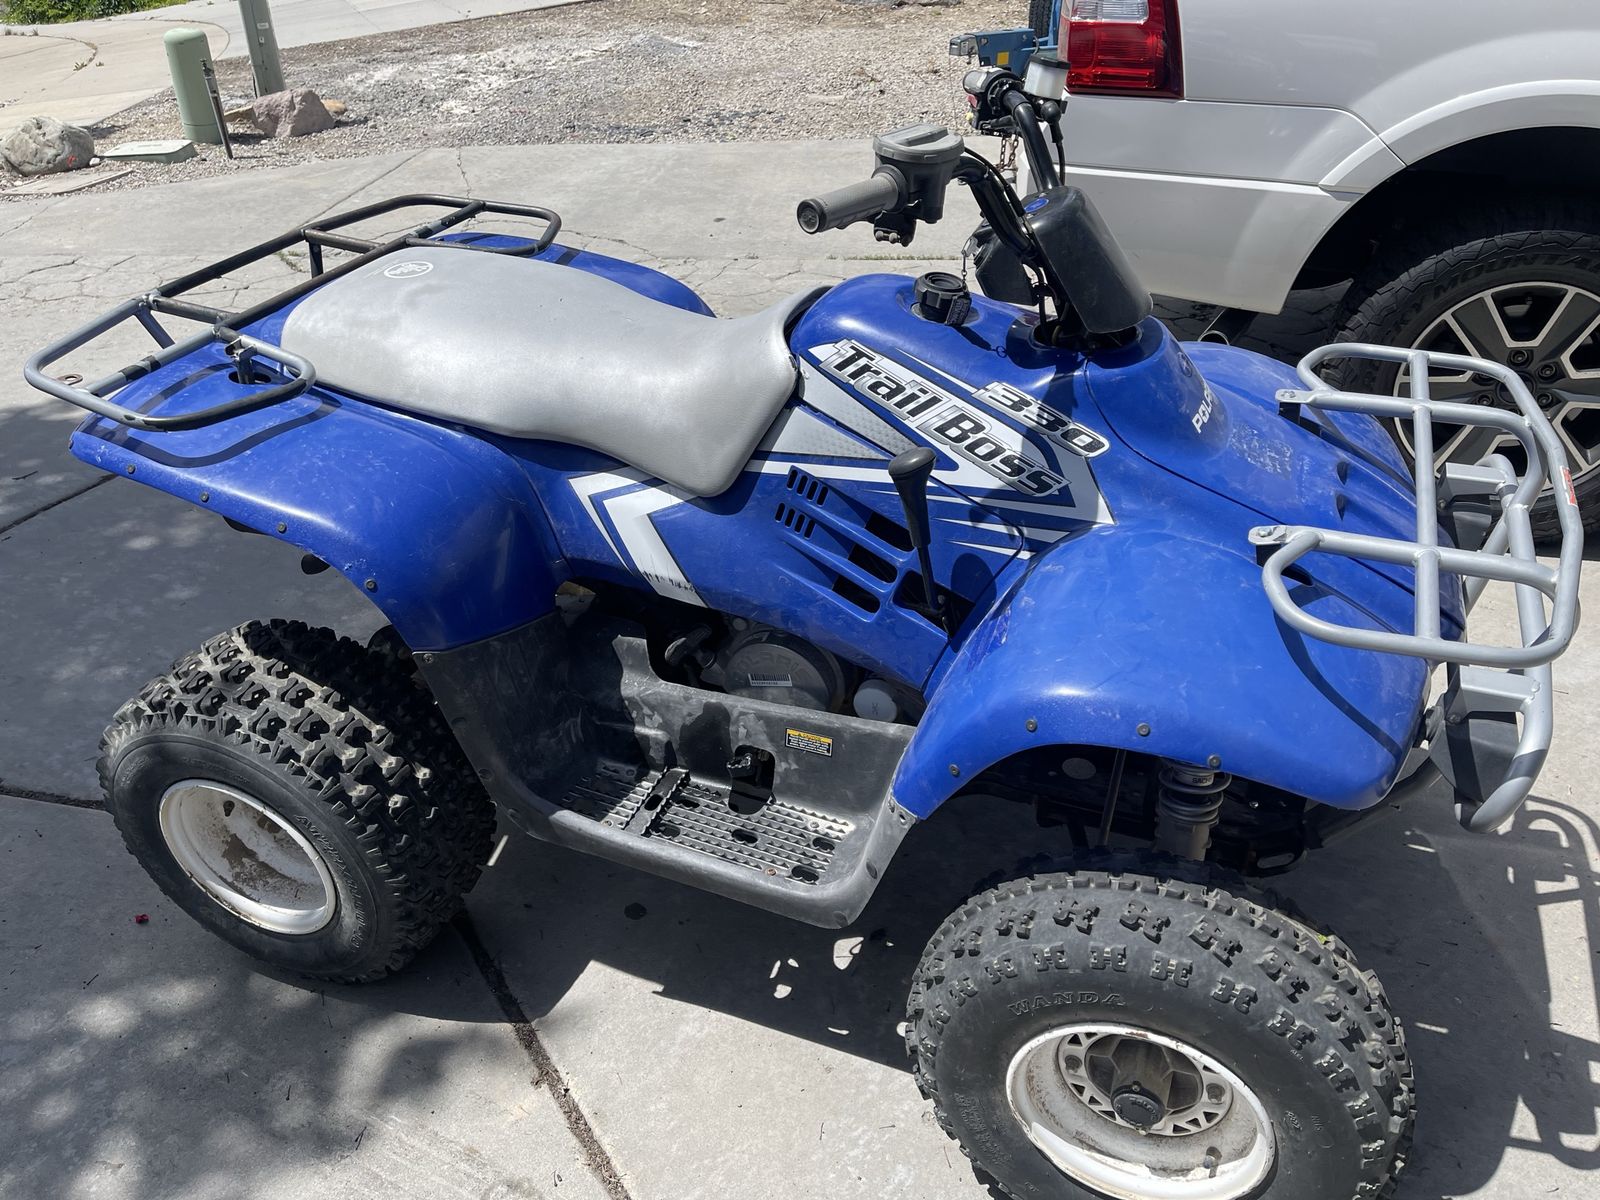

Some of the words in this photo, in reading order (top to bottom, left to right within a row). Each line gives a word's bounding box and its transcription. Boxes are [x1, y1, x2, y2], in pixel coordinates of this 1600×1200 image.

[831, 342, 947, 419] Trail
[931, 410, 1064, 496] Boss
[987, 382, 1110, 455] 330
[1007, 991, 1127, 1016] WANDA
